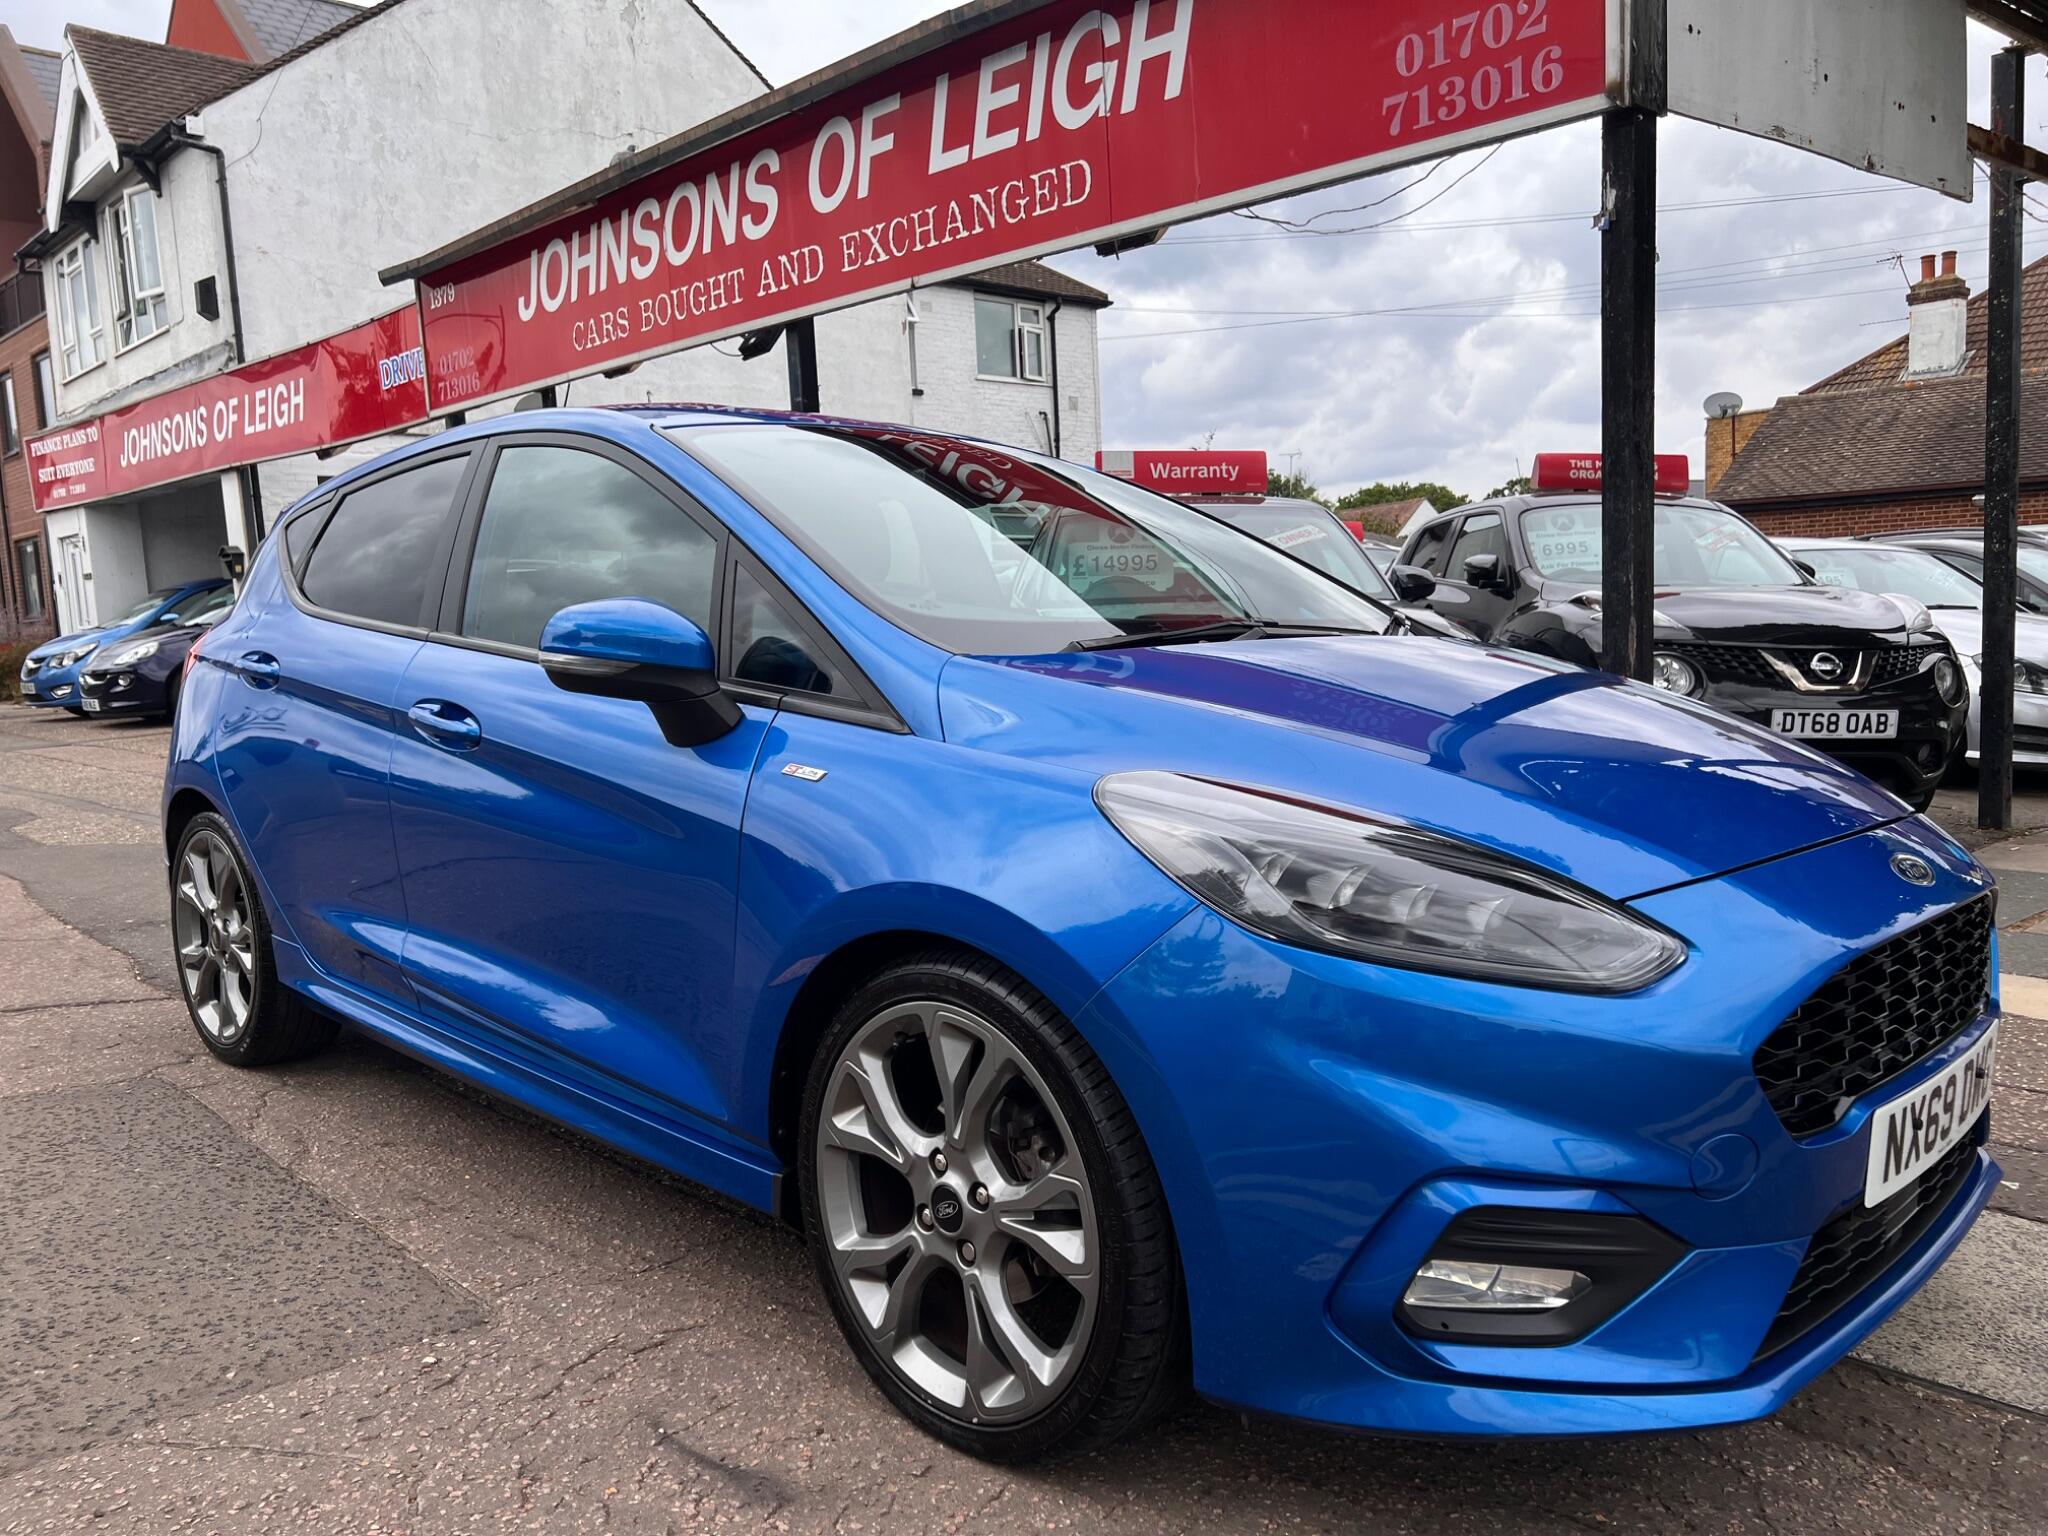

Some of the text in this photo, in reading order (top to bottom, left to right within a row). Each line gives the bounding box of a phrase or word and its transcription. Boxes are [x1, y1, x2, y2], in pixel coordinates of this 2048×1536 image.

[1395, 0, 1548, 77] 01702
[1382, 45, 1564, 137] 713016
[517, 0, 1194, 322] JOHNSONS OF LEIGH
[572, 159, 1092, 352] CARS BOUGHT AND EXCHANGED
[429, 282, 455, 310] 1379
[440, 346, 474, 376] 01702
[438, 371, 480, 402] 713016
[120, 377, 304, 468] JOHNSONS OF LEIGH
[30, 426, 98, 457] FINANCE PLANS TO
[38, 457, 95, 483] SUIT EVERYONE
[1149, 462, 1239, 481] Warranty
[1569, 459, 1592, 469] THE
[1781, 712, 1889, 734] DT68 OAB
[1882, 1073, 1957, 1184] NX69
